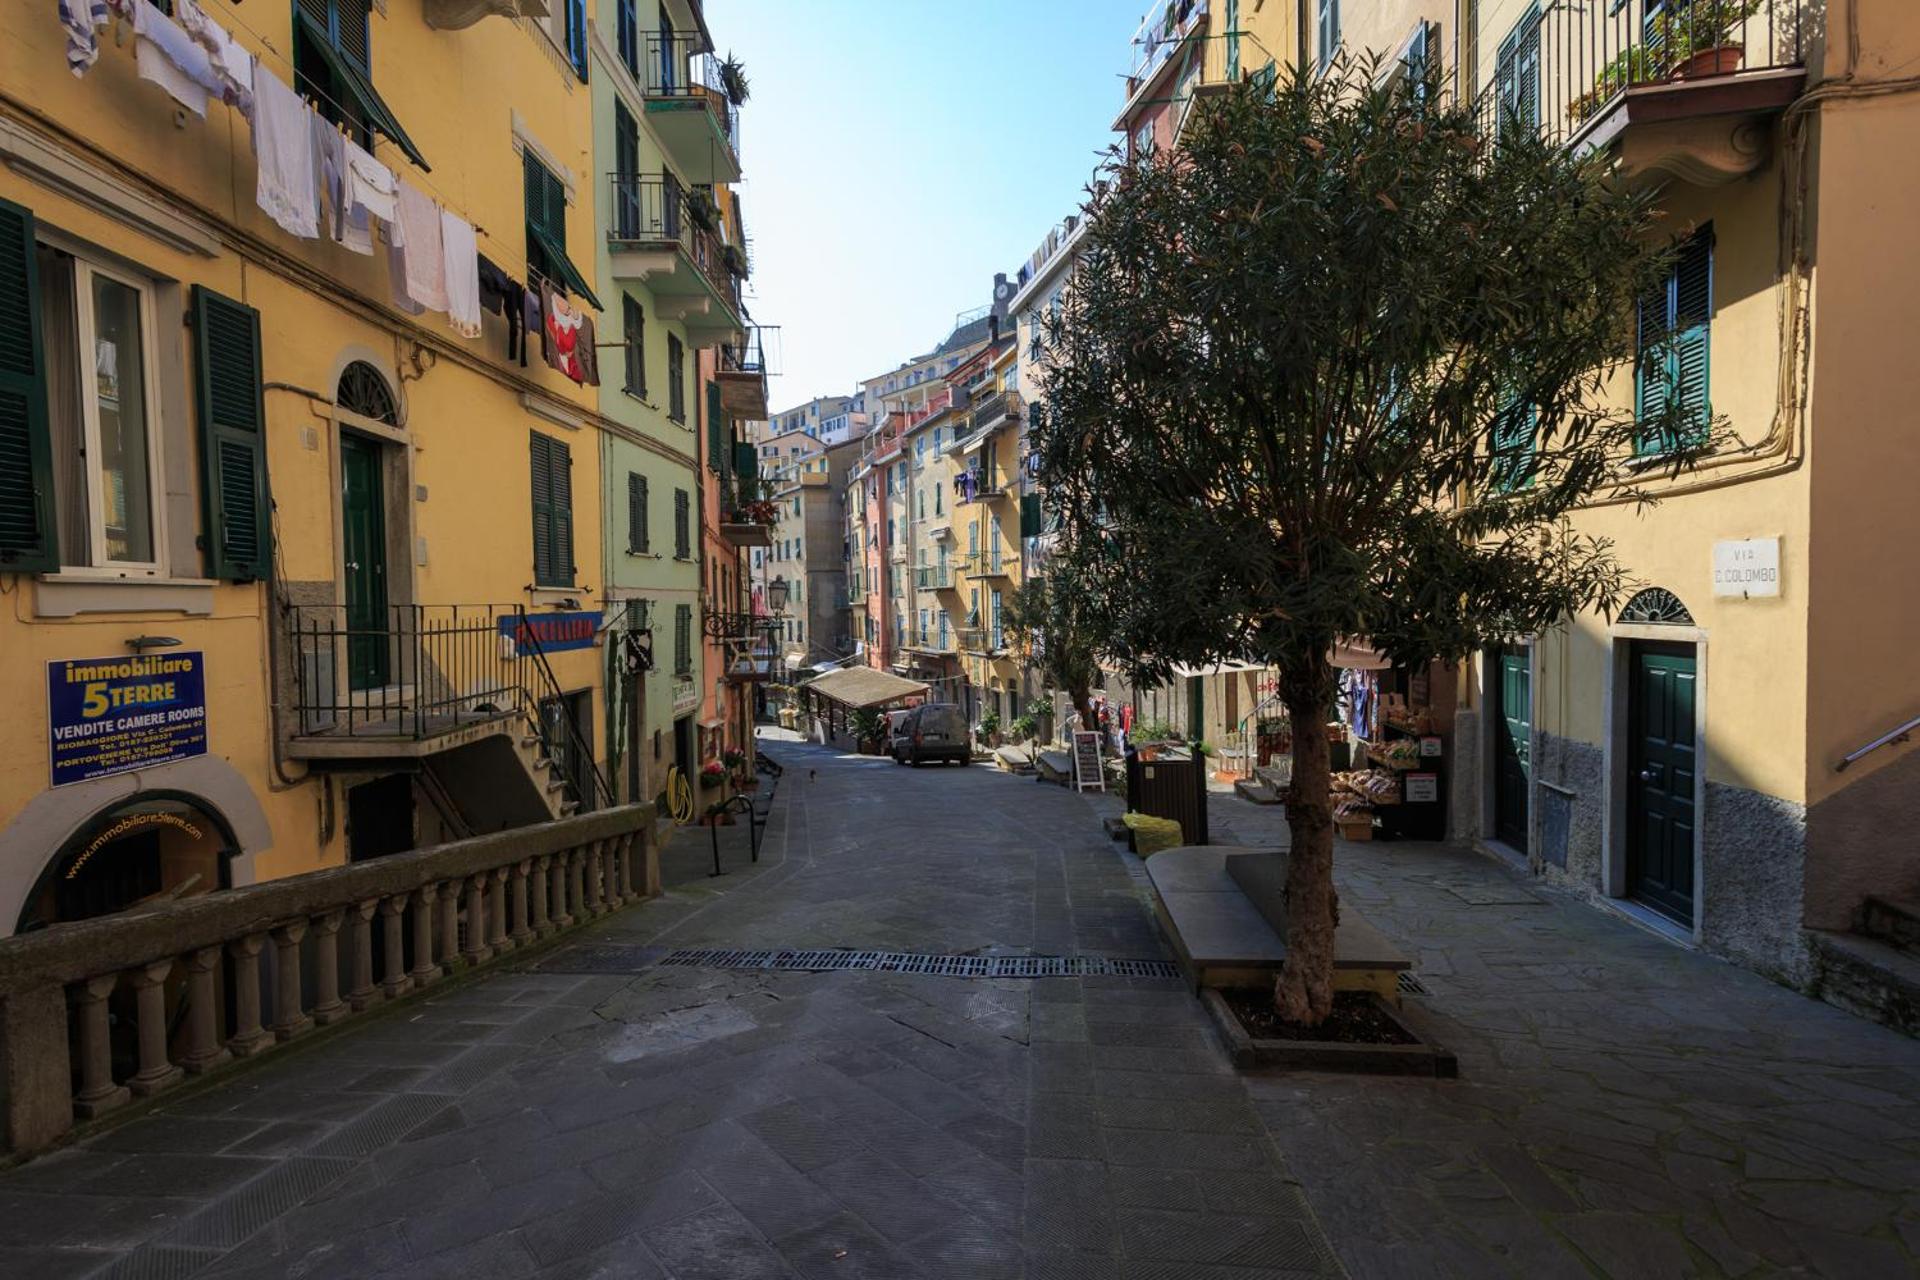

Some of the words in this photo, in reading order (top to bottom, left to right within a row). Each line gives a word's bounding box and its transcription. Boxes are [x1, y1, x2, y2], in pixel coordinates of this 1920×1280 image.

[1734, 549, 1754, 561] VIA
[66, 656, 192, 683] immobiliare
[54, 720, 114, 740] VENDITE
[117, 712, 166, 731] CAMERE
[168, 706, 204, 723] ROOMS
[57, 732, 130, 751] RIOMAGGIORE
[66, 811, 203, 879] www.immobiliare5terre.com
